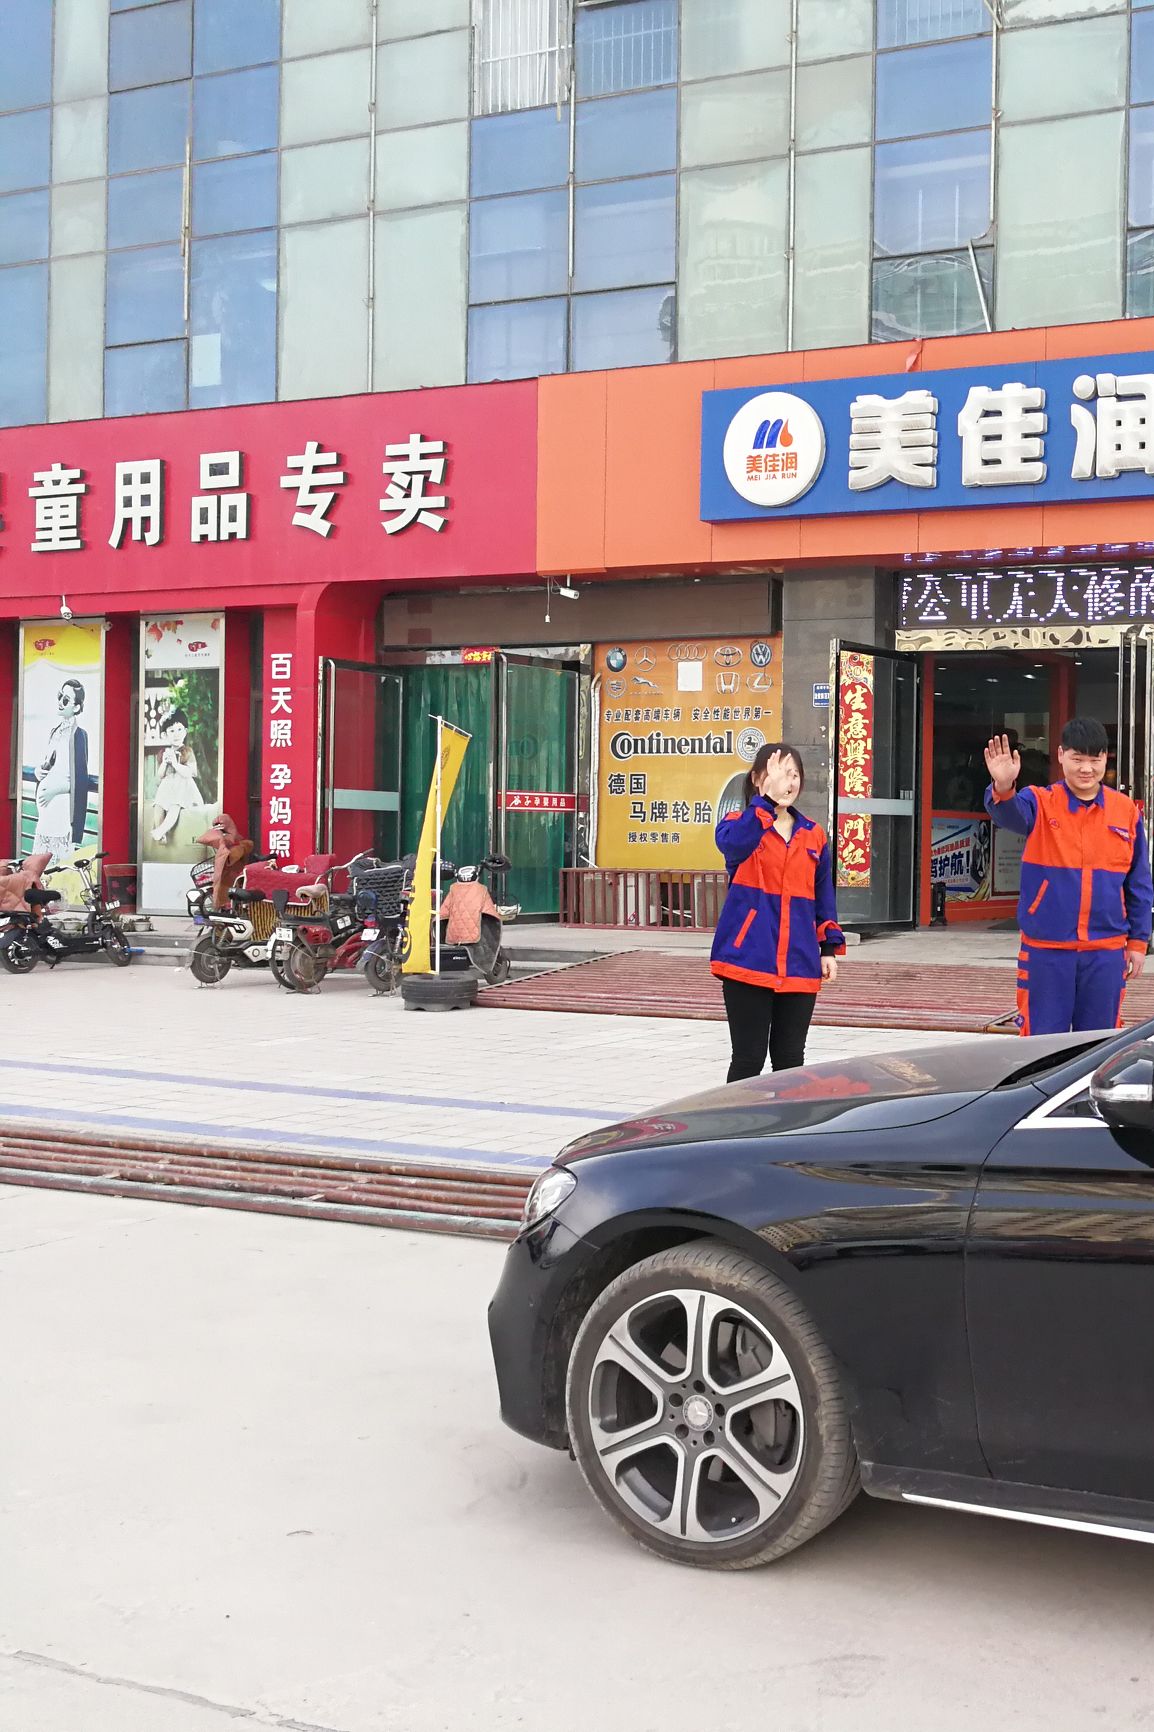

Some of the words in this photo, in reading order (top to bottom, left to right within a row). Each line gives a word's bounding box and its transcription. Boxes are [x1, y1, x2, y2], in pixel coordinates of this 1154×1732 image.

[746, 452, 798, 474] 美佳润
[0, 433, 448, 552] 童用品专卖
[270, 653, 292, 748] 百天照
[604, 707, 682, 723] 专业配套高端车辆
[692, 706, 772, 721] 安全性能世界第一
[610, 730, 734, 760] Continental
[608, 773, 647, 796] 德国
[269, 764, 292, 858] 孕妈照
[629, 800, 713, 824] 马牌轮胎
[628, 832, 680, 844] 授权零售商
